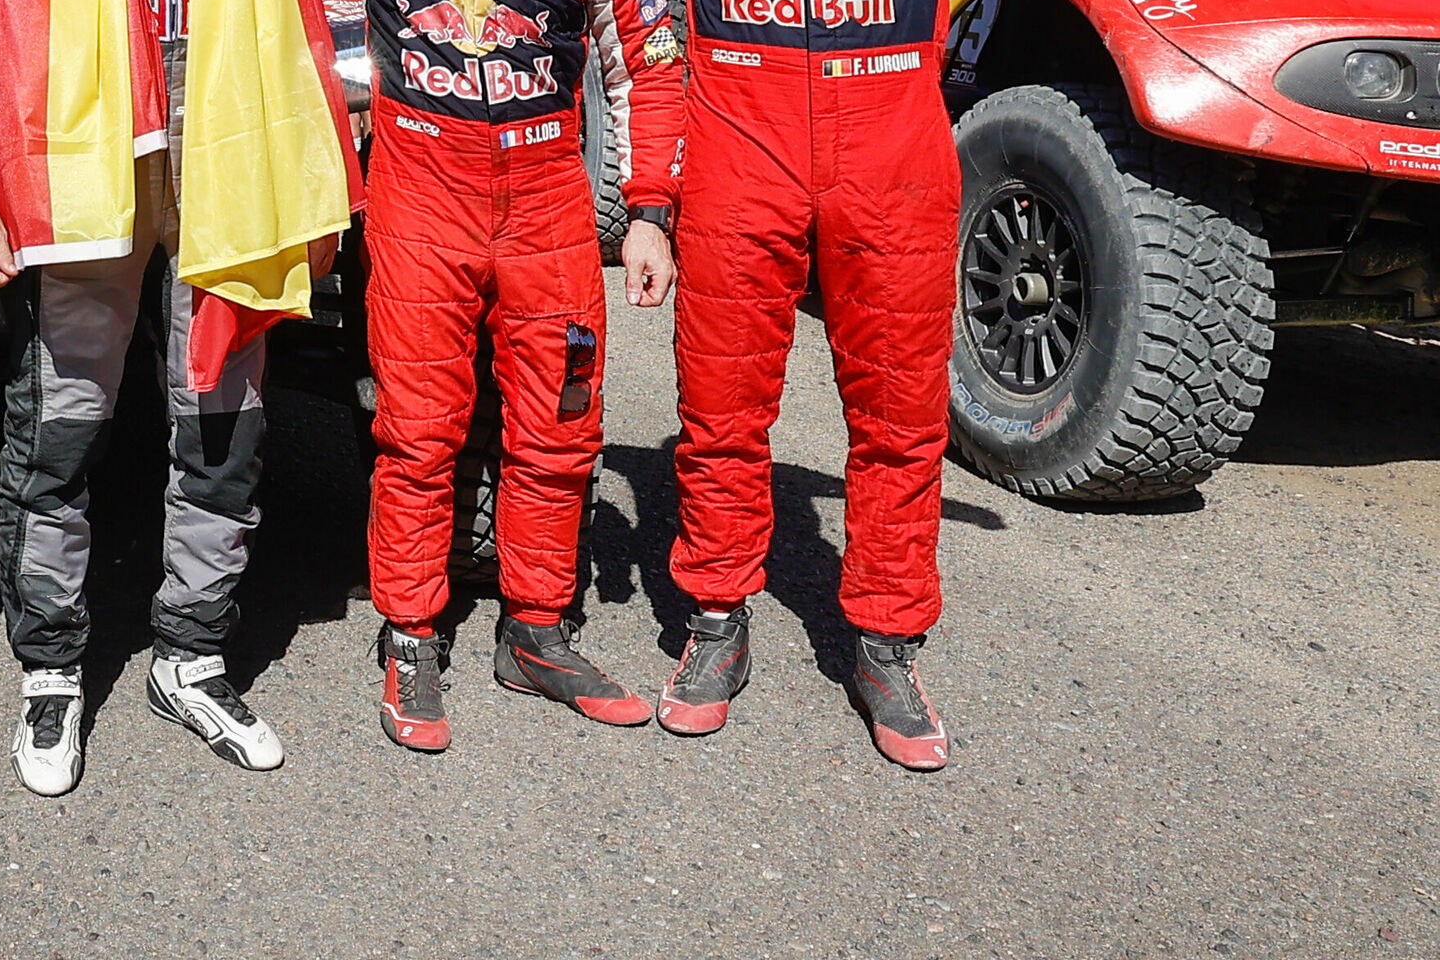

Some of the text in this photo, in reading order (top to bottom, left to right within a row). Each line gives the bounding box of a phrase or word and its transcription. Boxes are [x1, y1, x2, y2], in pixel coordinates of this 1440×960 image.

[712, 48, 762, 67] sparco
[853, 51, 921, 76] F. LURQUIN
[400, 47, 558, 106] Red Bull
[949, 69, 976, 84] 300
[396, 115, 440, 137] sparco
